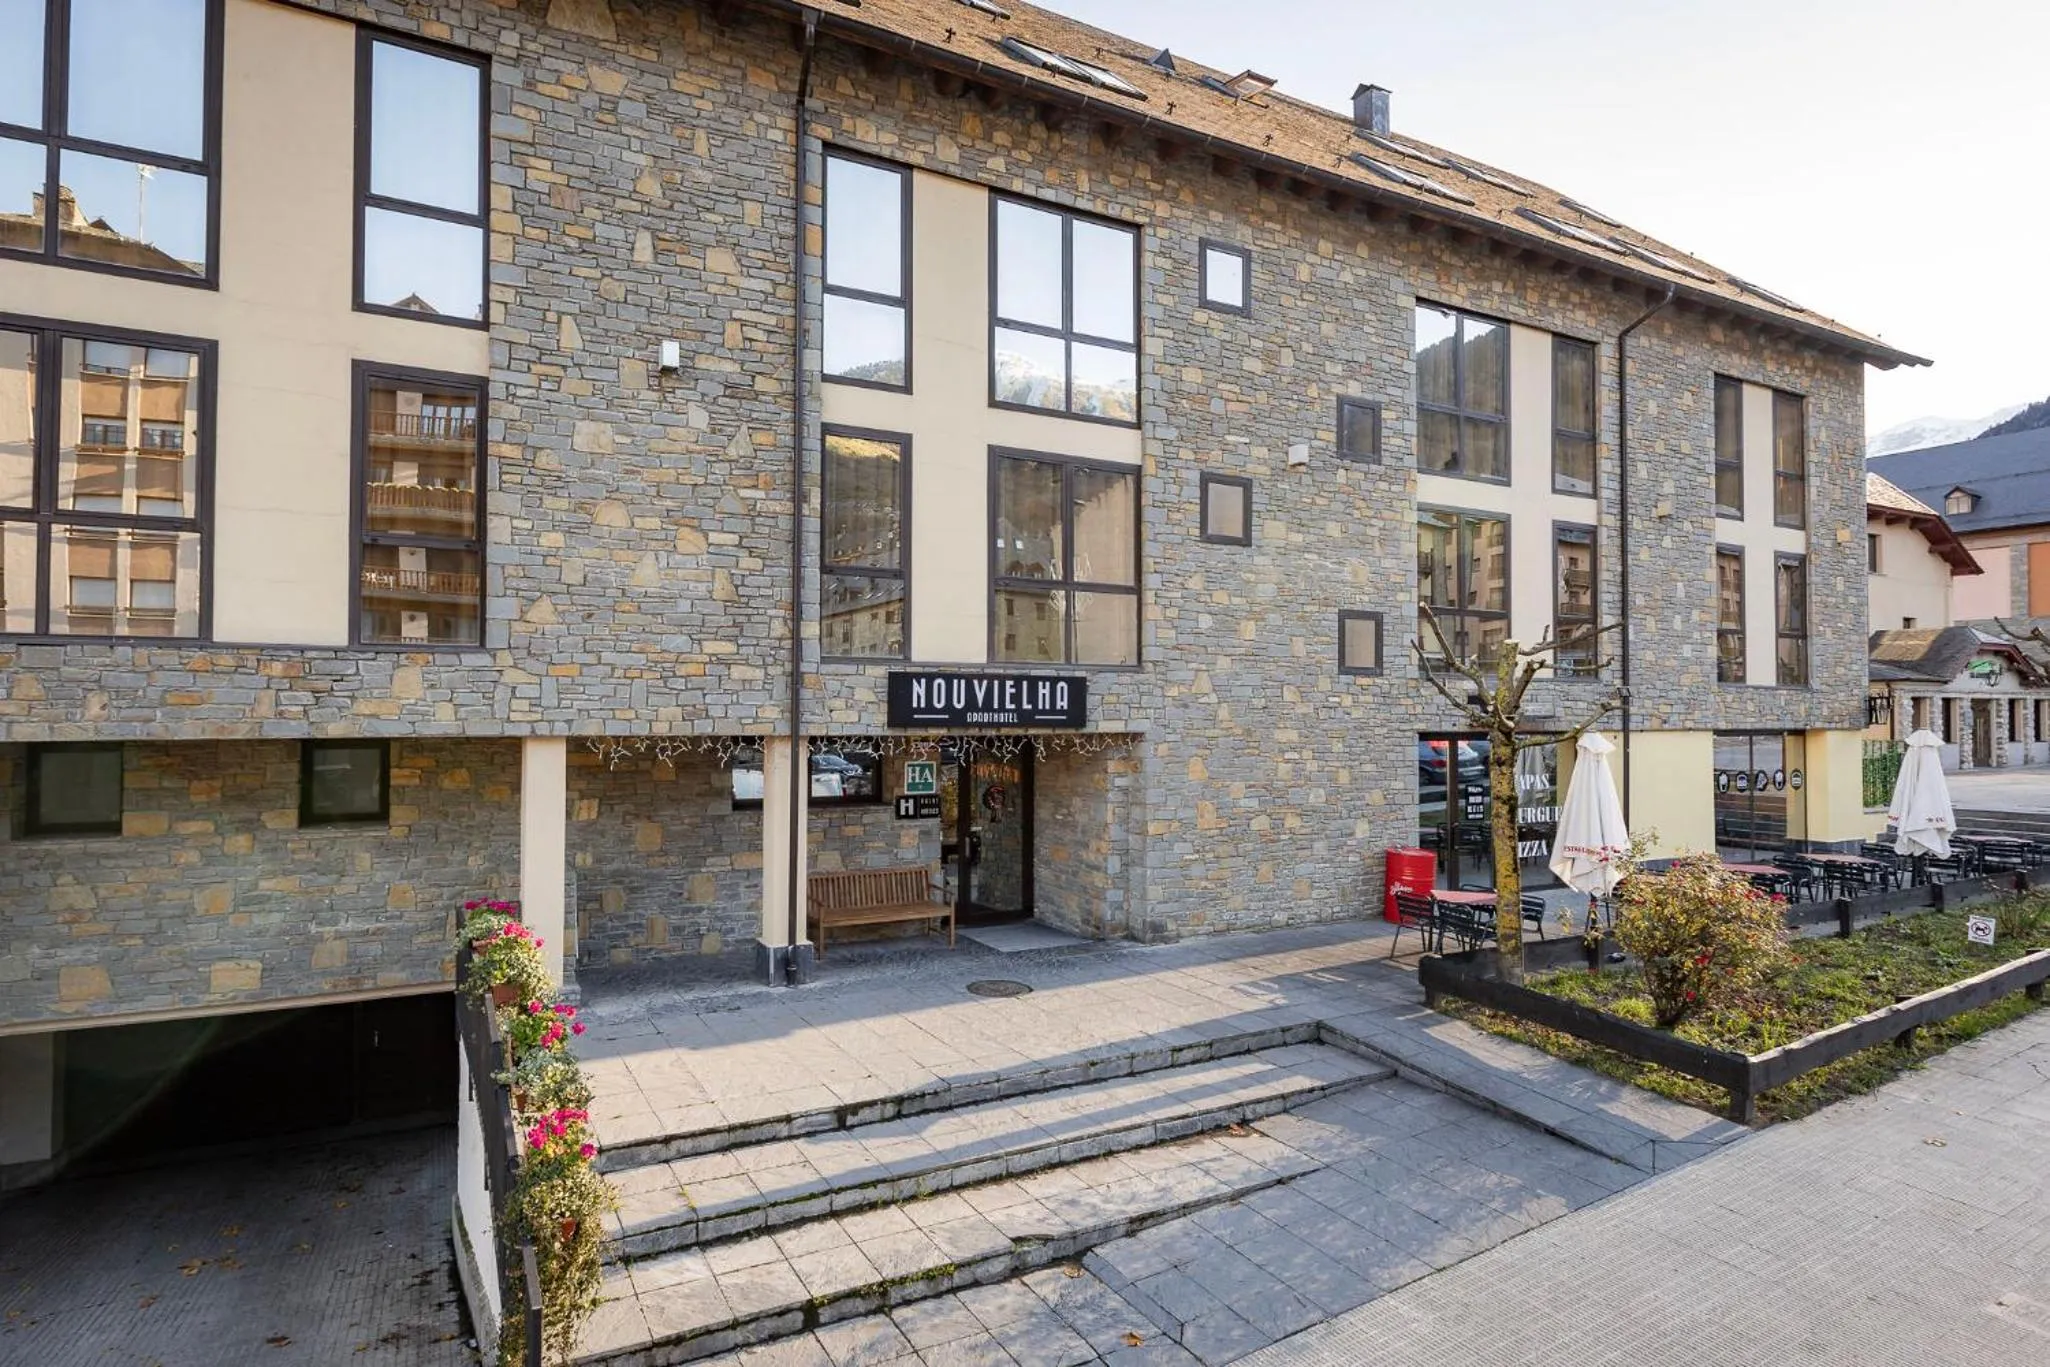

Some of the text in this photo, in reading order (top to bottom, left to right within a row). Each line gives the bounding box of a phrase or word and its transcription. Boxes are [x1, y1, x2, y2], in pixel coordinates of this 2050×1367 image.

[912, 677, 1068, 710] NOUVIELHA
[967, 712, 1018, 723] APARTHOTEL
[908, 766, 933, 783] HA
[1519, 773, 1550, 790] APAS
[900, 798, 914, 816] H
[1518, 839, 1548, 857] IZZA
